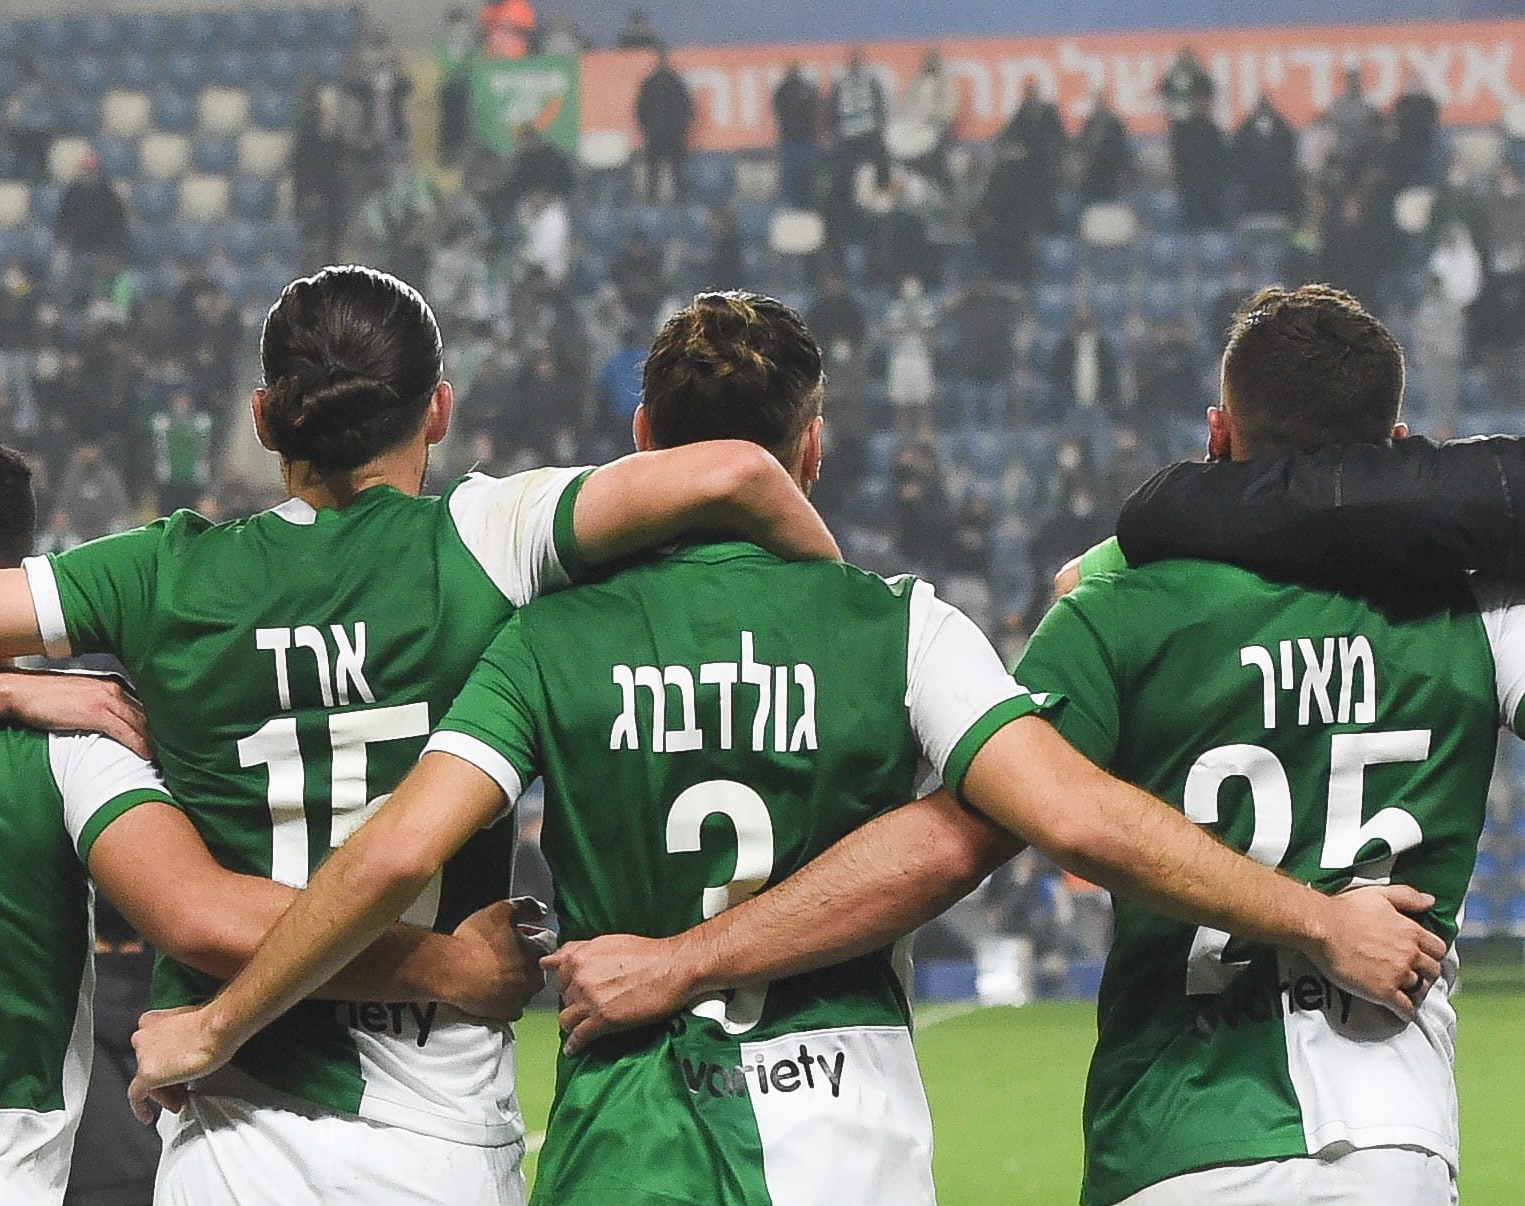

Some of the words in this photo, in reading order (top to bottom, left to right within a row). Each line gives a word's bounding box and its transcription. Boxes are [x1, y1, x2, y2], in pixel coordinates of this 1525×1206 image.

[256, 621, 376, 710] ארד
[609, 630, 818, 753] גולדברג
[1240, 635, 1376, 729] מאיר
[681, 1044, 845, 1098] variety
